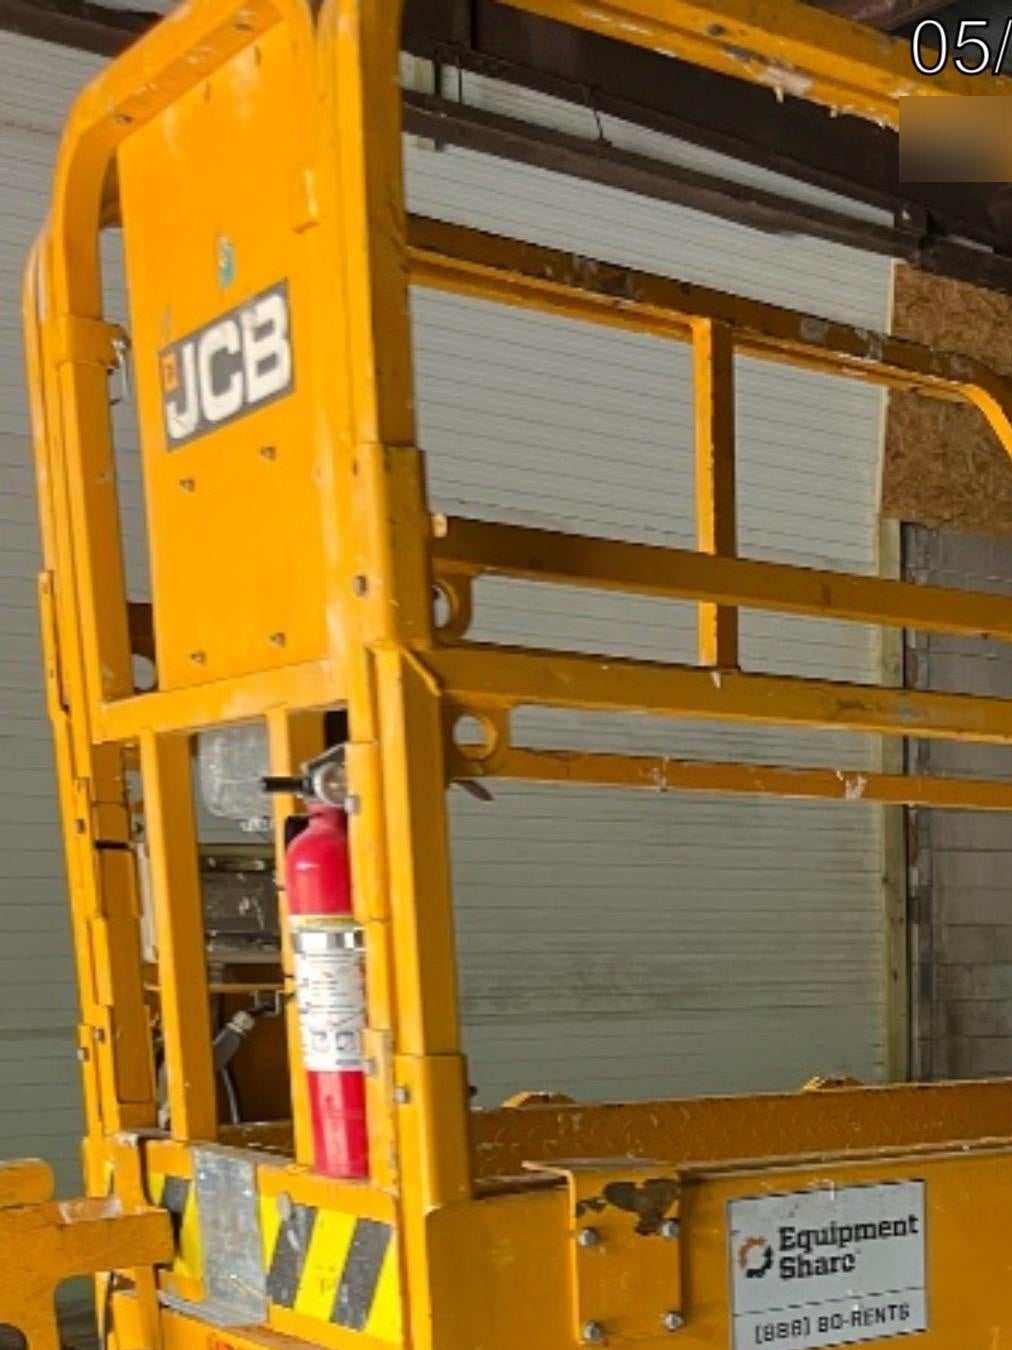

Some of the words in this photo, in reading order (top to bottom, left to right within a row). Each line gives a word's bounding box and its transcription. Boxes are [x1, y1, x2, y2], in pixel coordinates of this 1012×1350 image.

[165, 293, 292, 439] JCB
[778, 1214, 919, 1253] Equipment
[778, 1253, 856, 1280] Share
